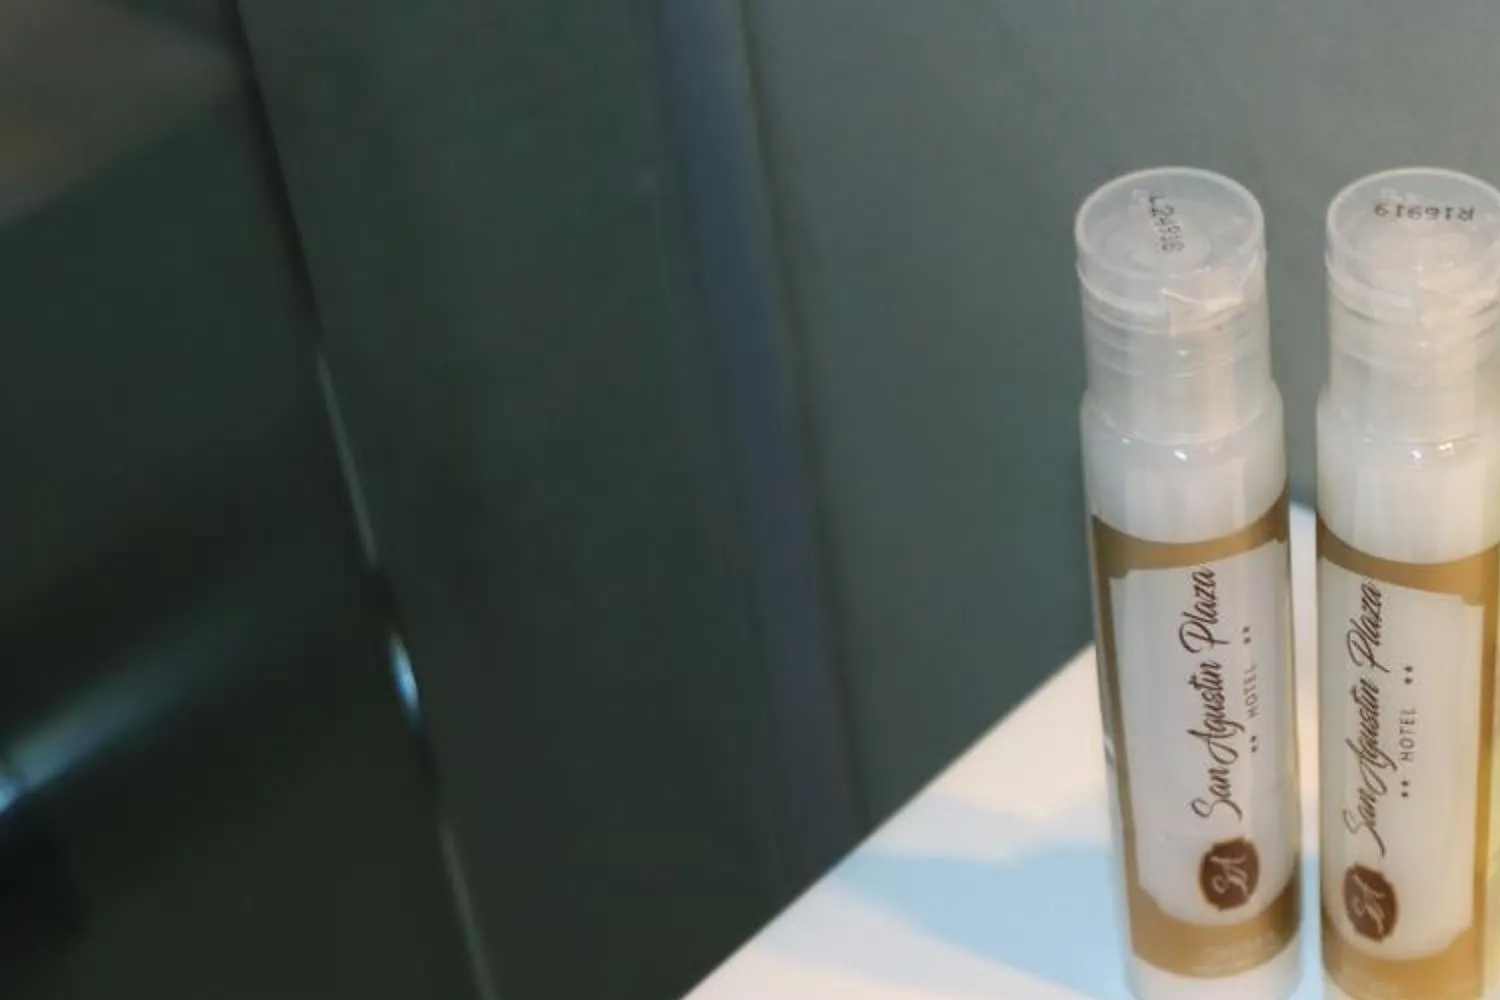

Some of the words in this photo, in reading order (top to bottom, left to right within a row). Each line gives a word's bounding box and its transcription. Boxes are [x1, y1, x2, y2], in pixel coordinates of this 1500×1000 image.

[1178, 567, 1231, 654] Plaza
[1345, 582, 1392, 674] Plaza
[1243, 664, 1260, 719] HOTEL
[1399, 706, 1417, 763] HOTEL
[1190, 767, 1243, 823] San
[1342, 787, 1386, 858] San
